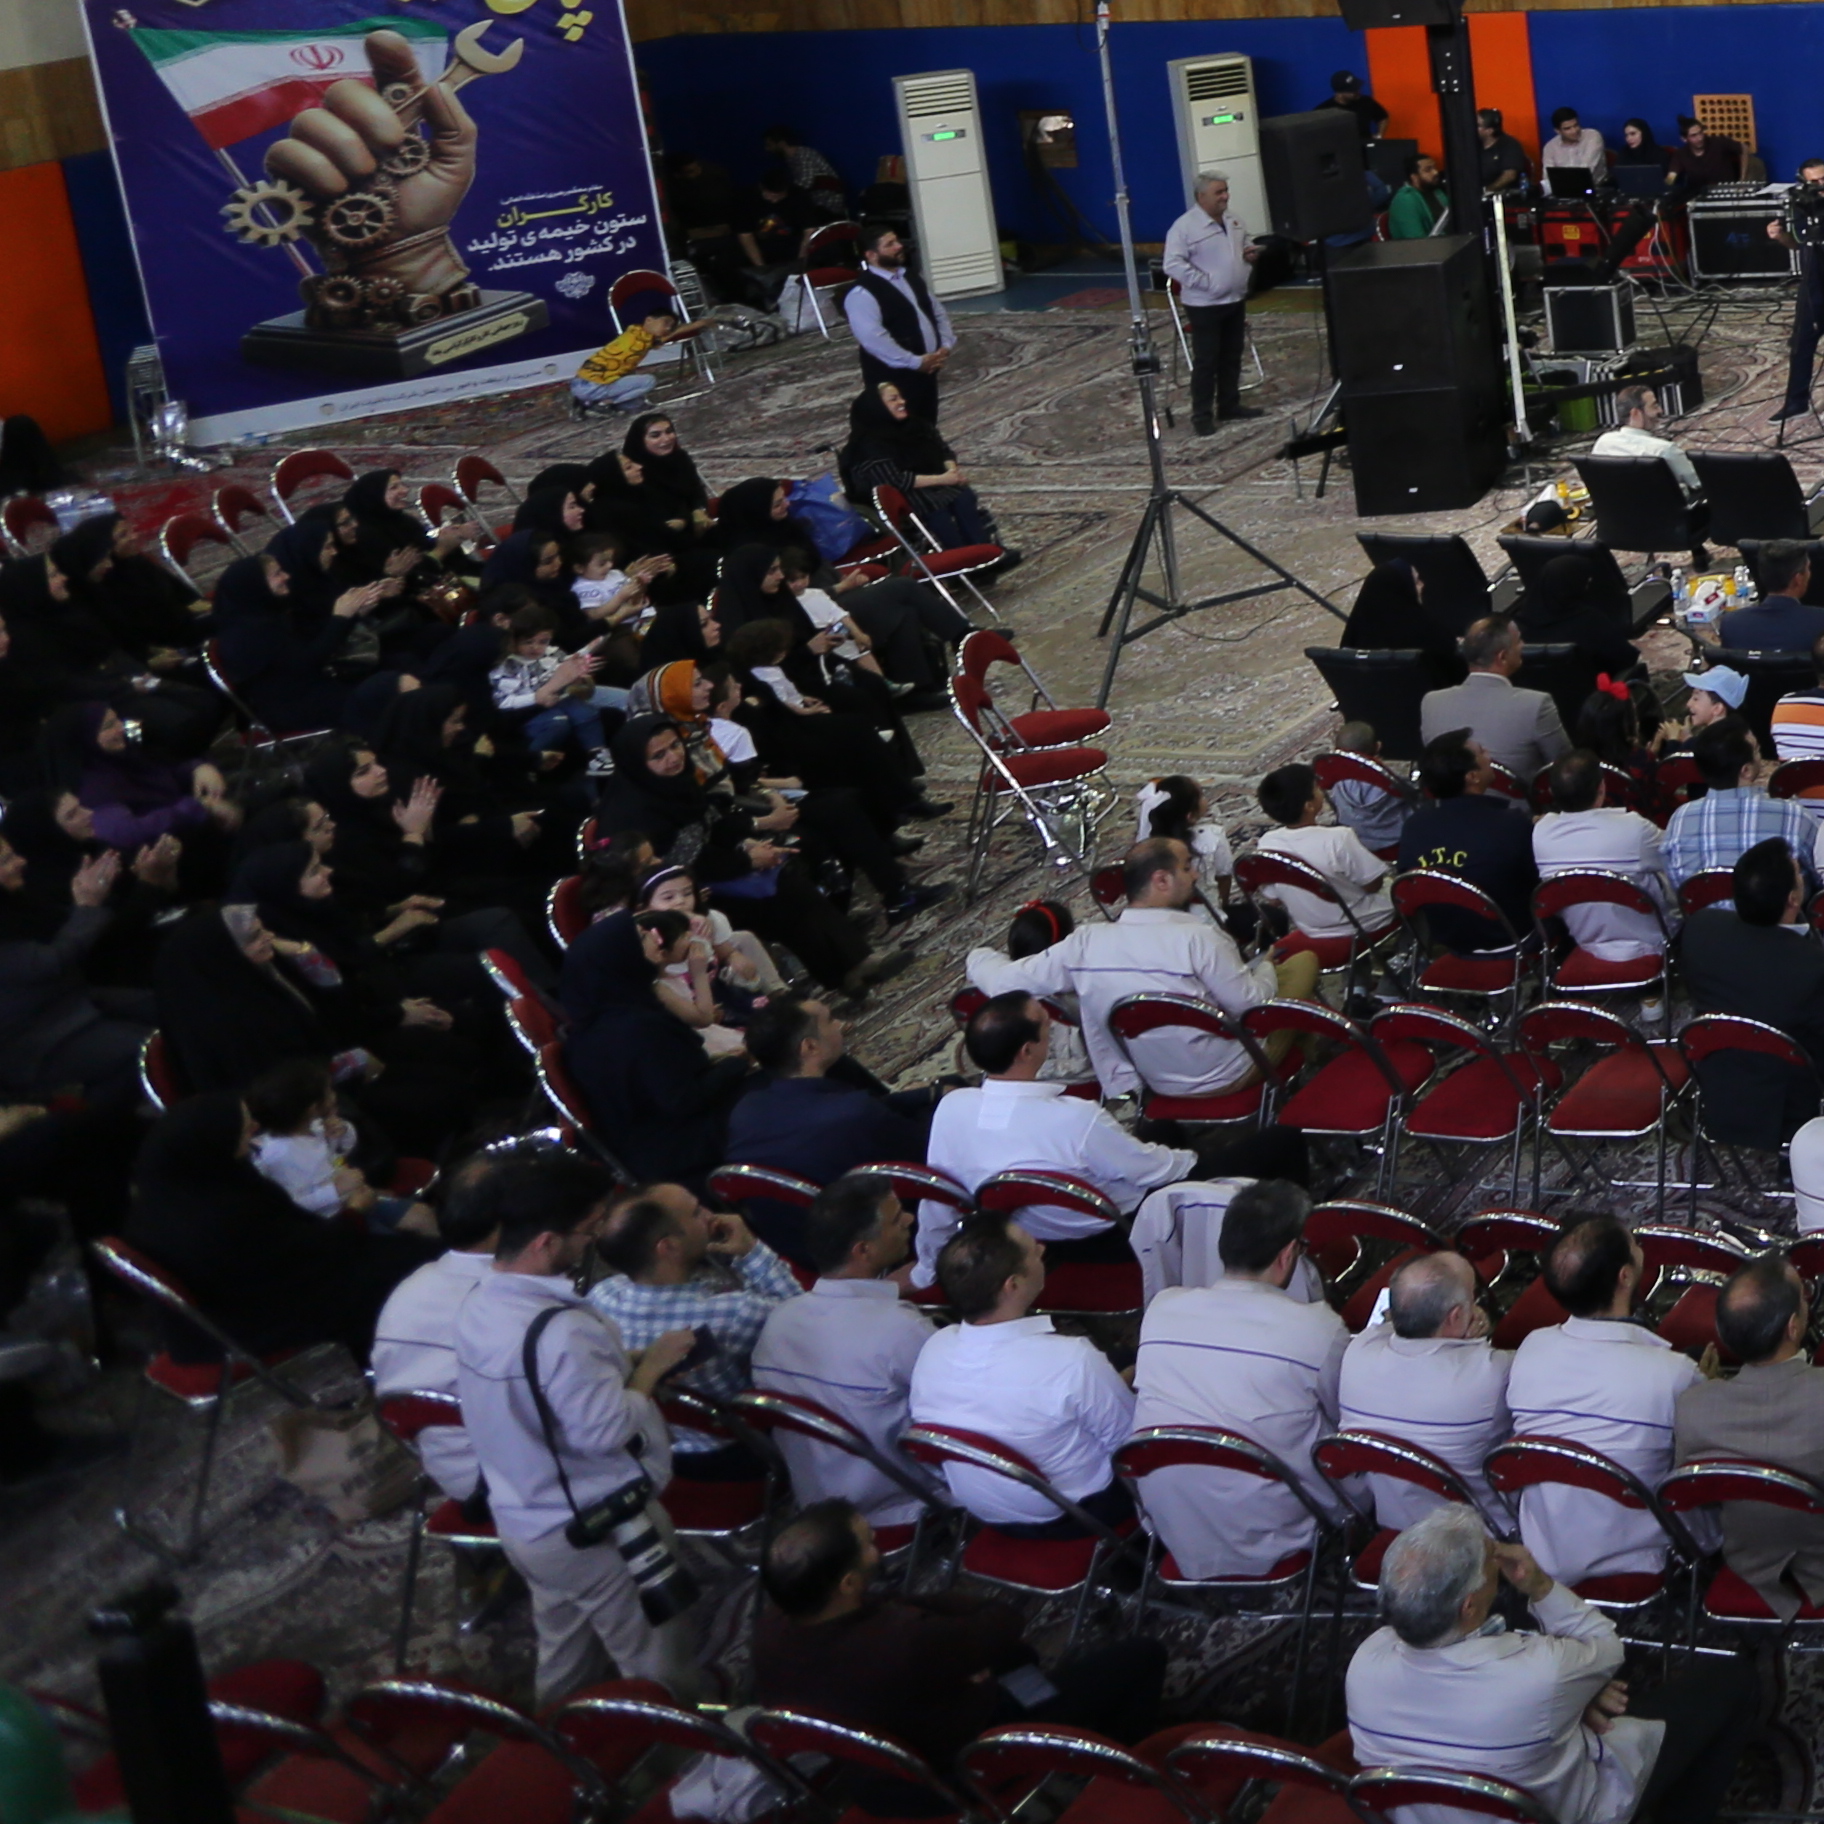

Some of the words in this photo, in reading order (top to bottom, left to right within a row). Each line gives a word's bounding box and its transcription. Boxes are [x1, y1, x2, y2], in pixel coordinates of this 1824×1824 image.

[495, 191, 614, 228] کارگران
[593, 213, 648, 235] ستون
[467, 229, 518, 255] تولید
[563, 236, 614, 264] کشور
[615, 236, 638, 255] در
